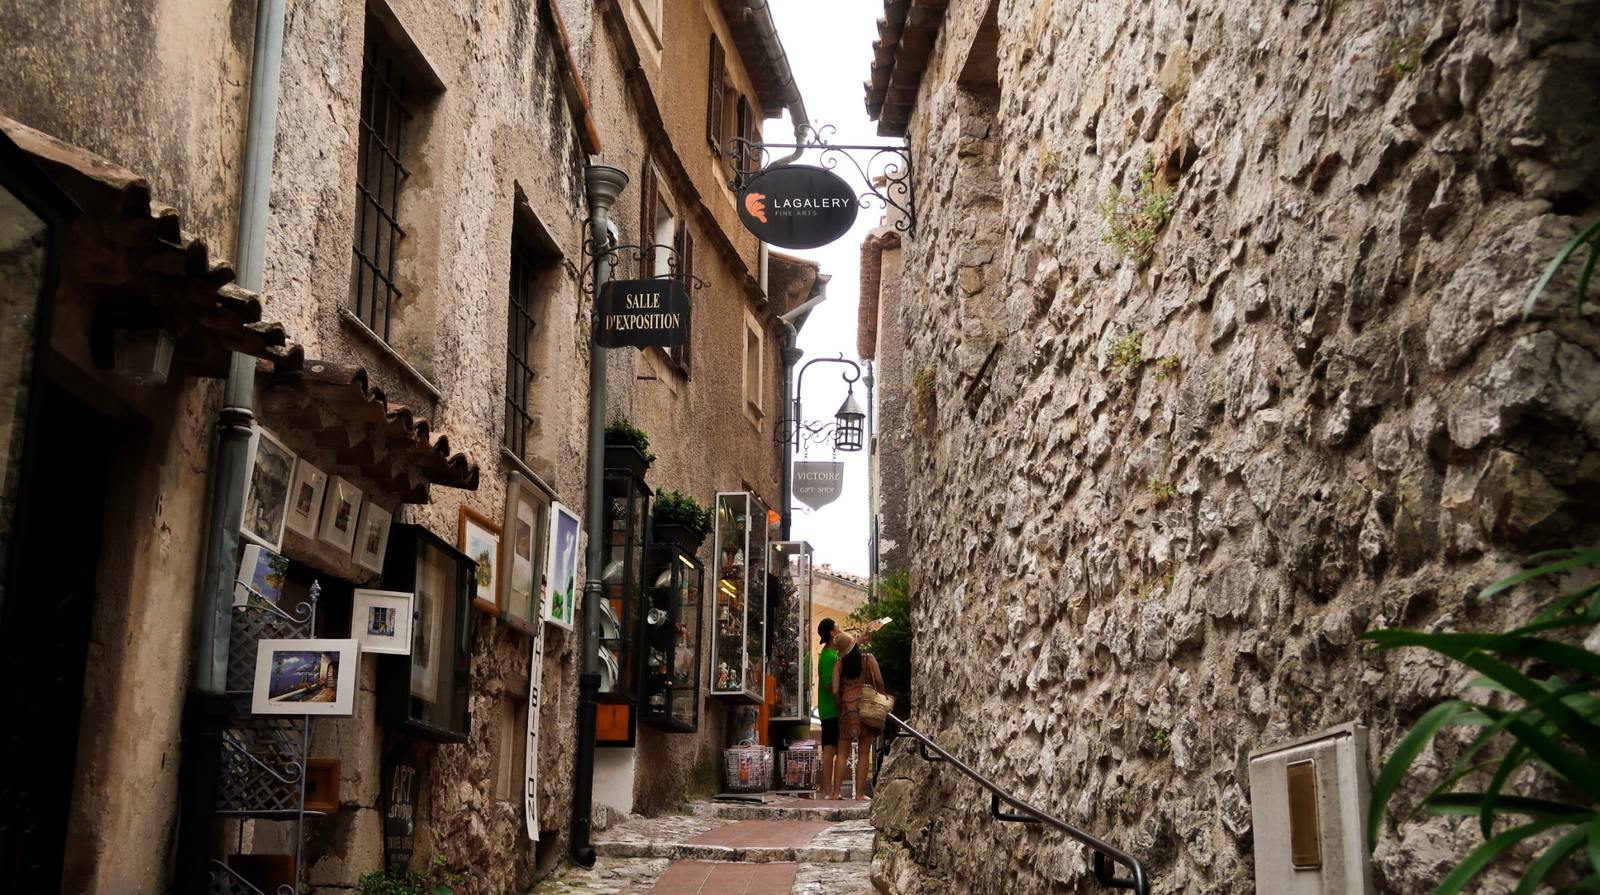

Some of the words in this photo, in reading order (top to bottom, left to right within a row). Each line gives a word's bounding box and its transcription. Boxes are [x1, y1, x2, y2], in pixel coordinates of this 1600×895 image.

[774, 198, 850, 209] LAGALERY
[626, 293, 660, 309] SALLE
[606, 313, 680, 331] D'EXPOSITION
[797, 471, 840, 481] VICTOIRE
[799, 486, 815, 494] GIFT
[391, 764, 416, 802] ART
